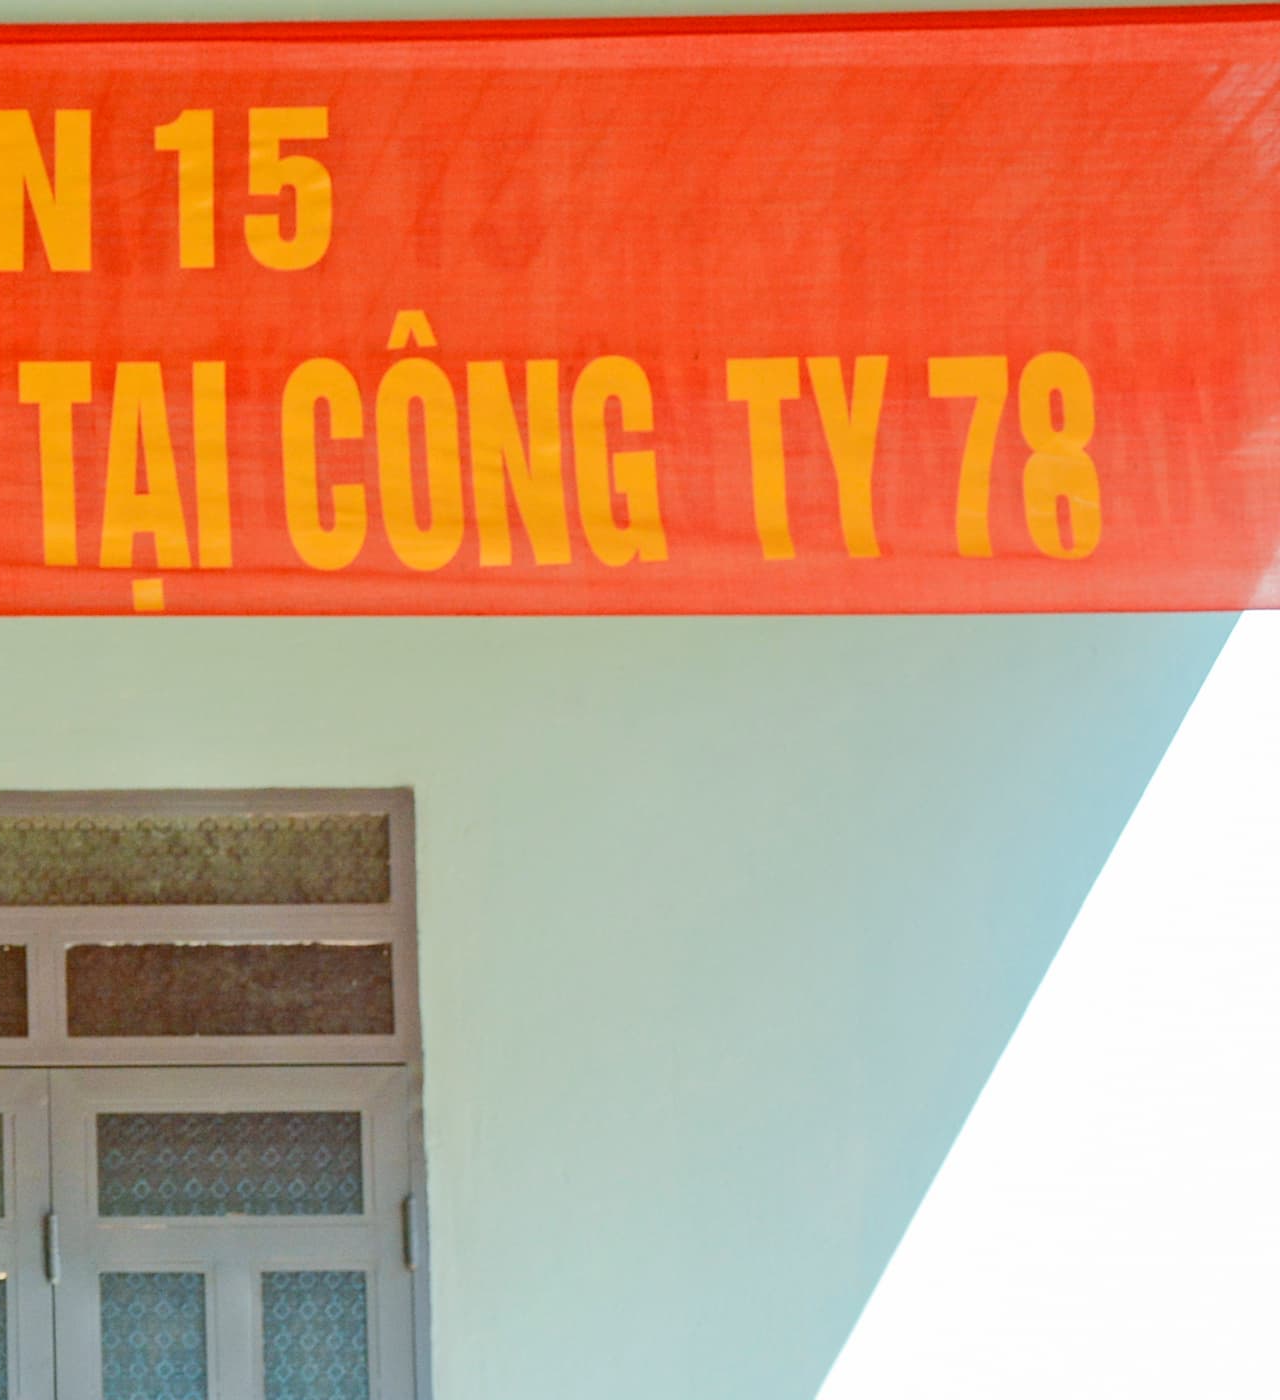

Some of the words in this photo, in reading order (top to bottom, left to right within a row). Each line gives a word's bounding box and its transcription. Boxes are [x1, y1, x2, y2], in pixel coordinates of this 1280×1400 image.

[153, 106, 333, 271] 15
[18, 360, 232, 611] TẠI
[281, 310, 668, 571] CÔNG
[726, 355, 888, 560] TY
[928, 351, 1102, 560] 78
